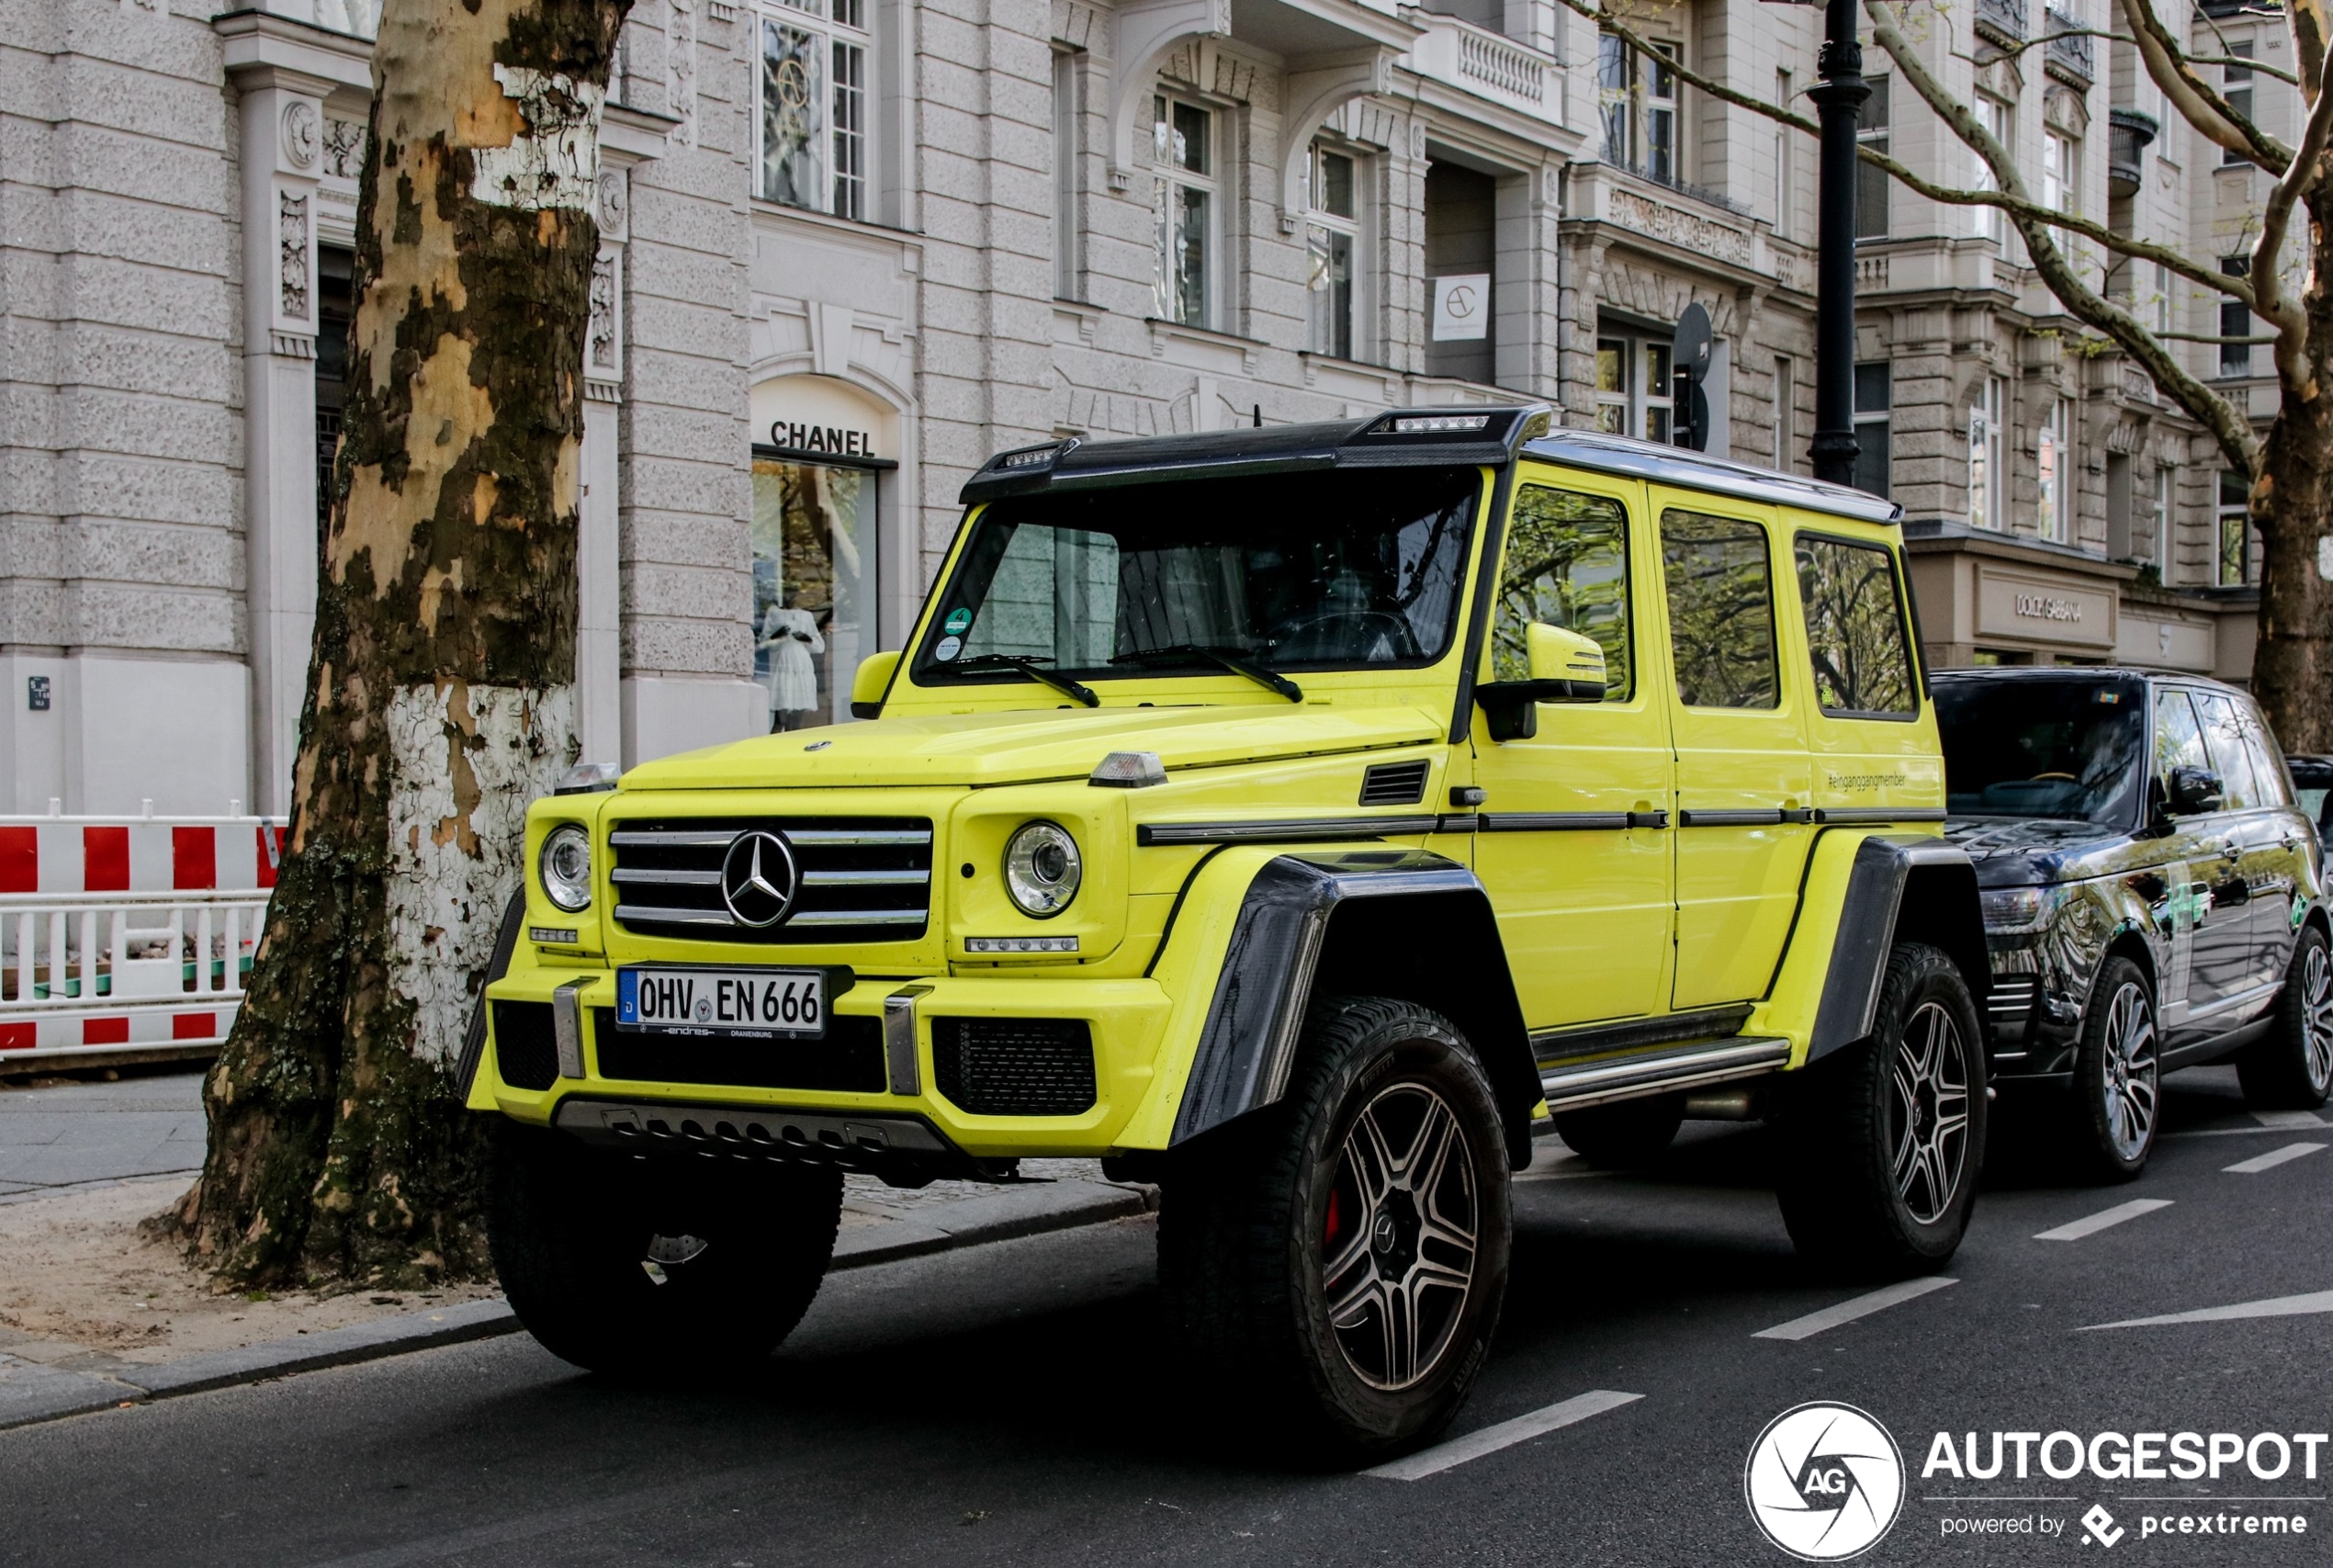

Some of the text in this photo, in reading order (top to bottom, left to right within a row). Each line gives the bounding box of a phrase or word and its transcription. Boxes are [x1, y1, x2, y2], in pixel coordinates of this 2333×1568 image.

[771, 421, 875, 458] CHANEL
[955, 609, 964, 621] 4
[2016, 594, 2081, 622] DOLCE GABBANA
[1828, 771, 1906, 792] #einganggangmember
[640, 977, 818, 1023] OHV EN 666
[731, 1030, 772, 1038] ORANIENBURG
[1359, 1050, 1394, 1092] PIRELLI
[1452, 1337, 1484, 1393] PIRELLI
